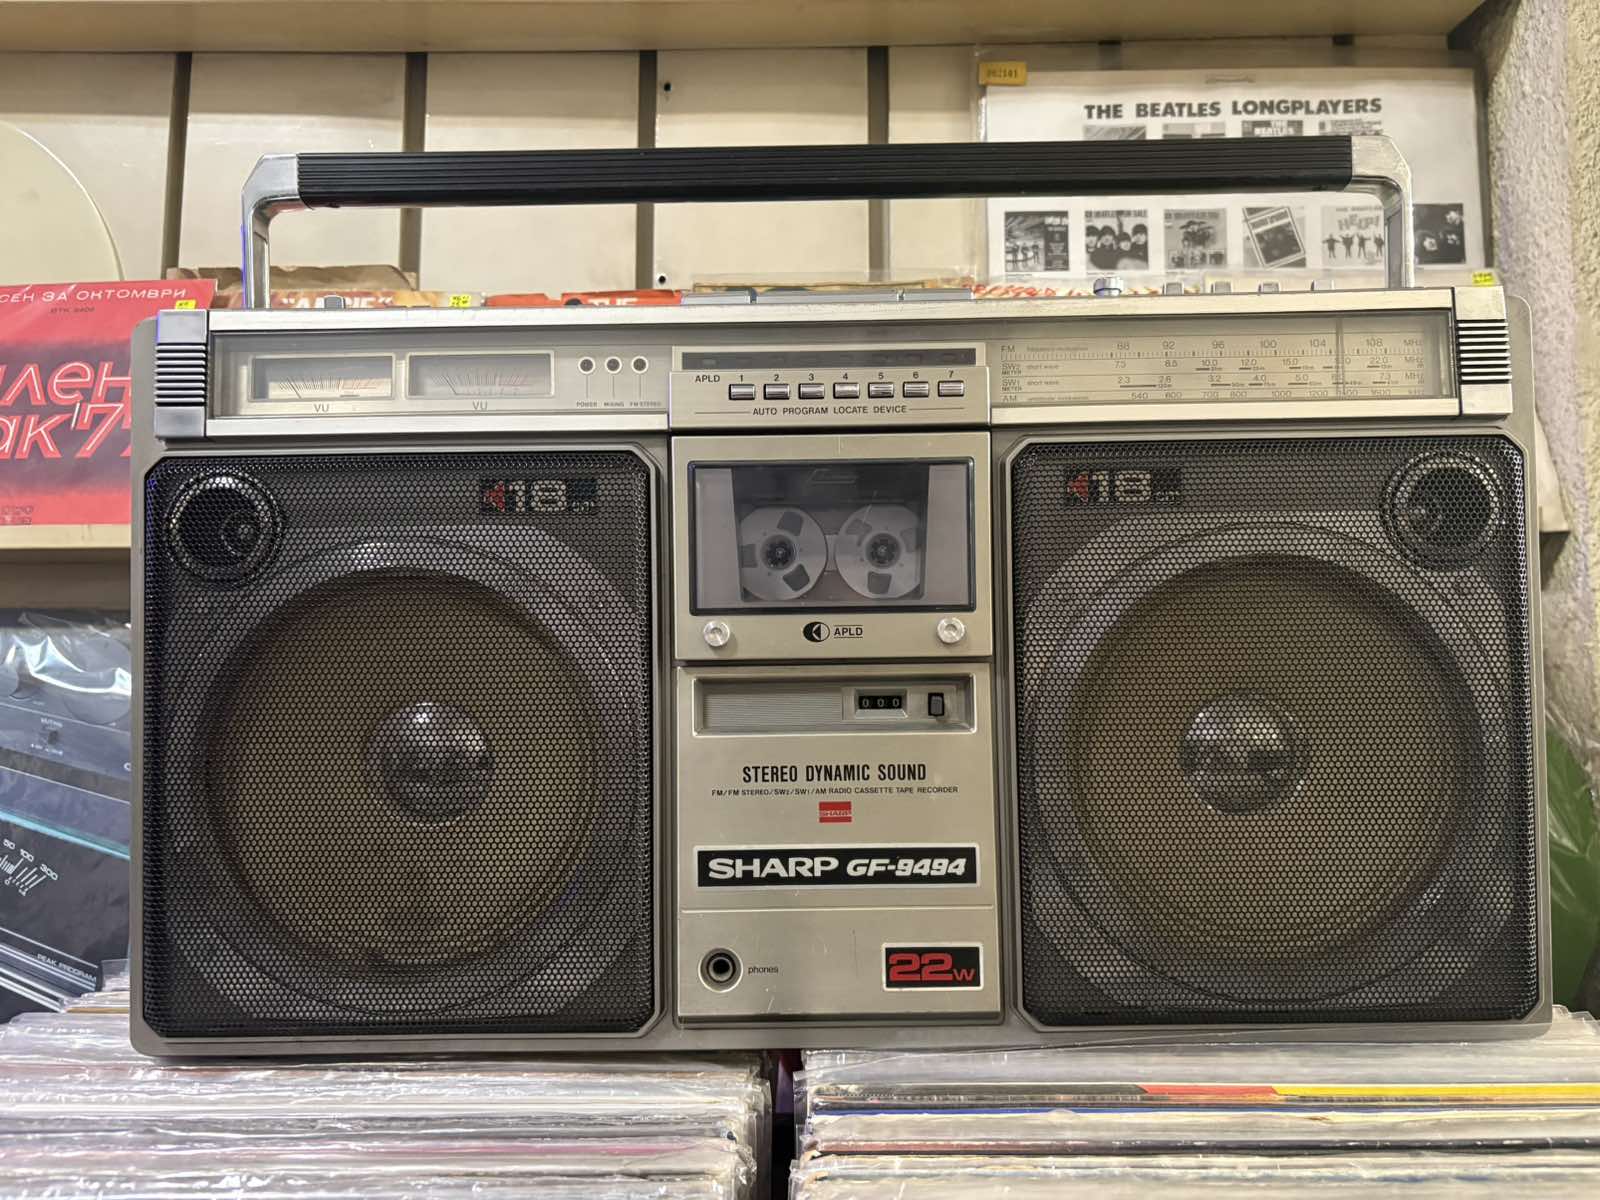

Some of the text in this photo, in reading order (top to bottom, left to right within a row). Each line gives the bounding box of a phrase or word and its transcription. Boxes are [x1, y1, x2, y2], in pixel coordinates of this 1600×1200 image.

[1084, 97, 1382, 119] THE BEATLES LONGPLAYERS
[42, 291, 67, 303] ЗА
[76, 288, 187, 301] ОКТОМВРИ
[1162, 341, 1175, 350] 92
[1260, 339, 1278, 349] 100
[1310, 338, 1326, 347] 104
[1366, 338, 1383, 347] 108
[695, 370, 954, 383] APLD 1 2 3 4 5 6 7
[314, 404, 330, 413] VU
[472, 401, 488, 411] VU
[753, 405, 907, 416] AUTO PROGRAM LOCATE DEVICE
[834, 627, 863, 636] APLD
[742, 763, 926, 783] STEREO DYNAMIC SOUND
[711, 789, 739, 797] FM/FM
[828, 787, 852, 795] RADIO
[854, 786, 893, 794] CASSETTE
[896, 786, 915, 794] TAPE
[917, 785, 959, 794] RECORDER
[20, 849, 34, 863] 100
[40, 863, 59, 881] 300
[708, 856, 967, 880] SHARP GF-9494
[37, 953, 57, 967] PEAK
[748, 965, 779, 975] phones
